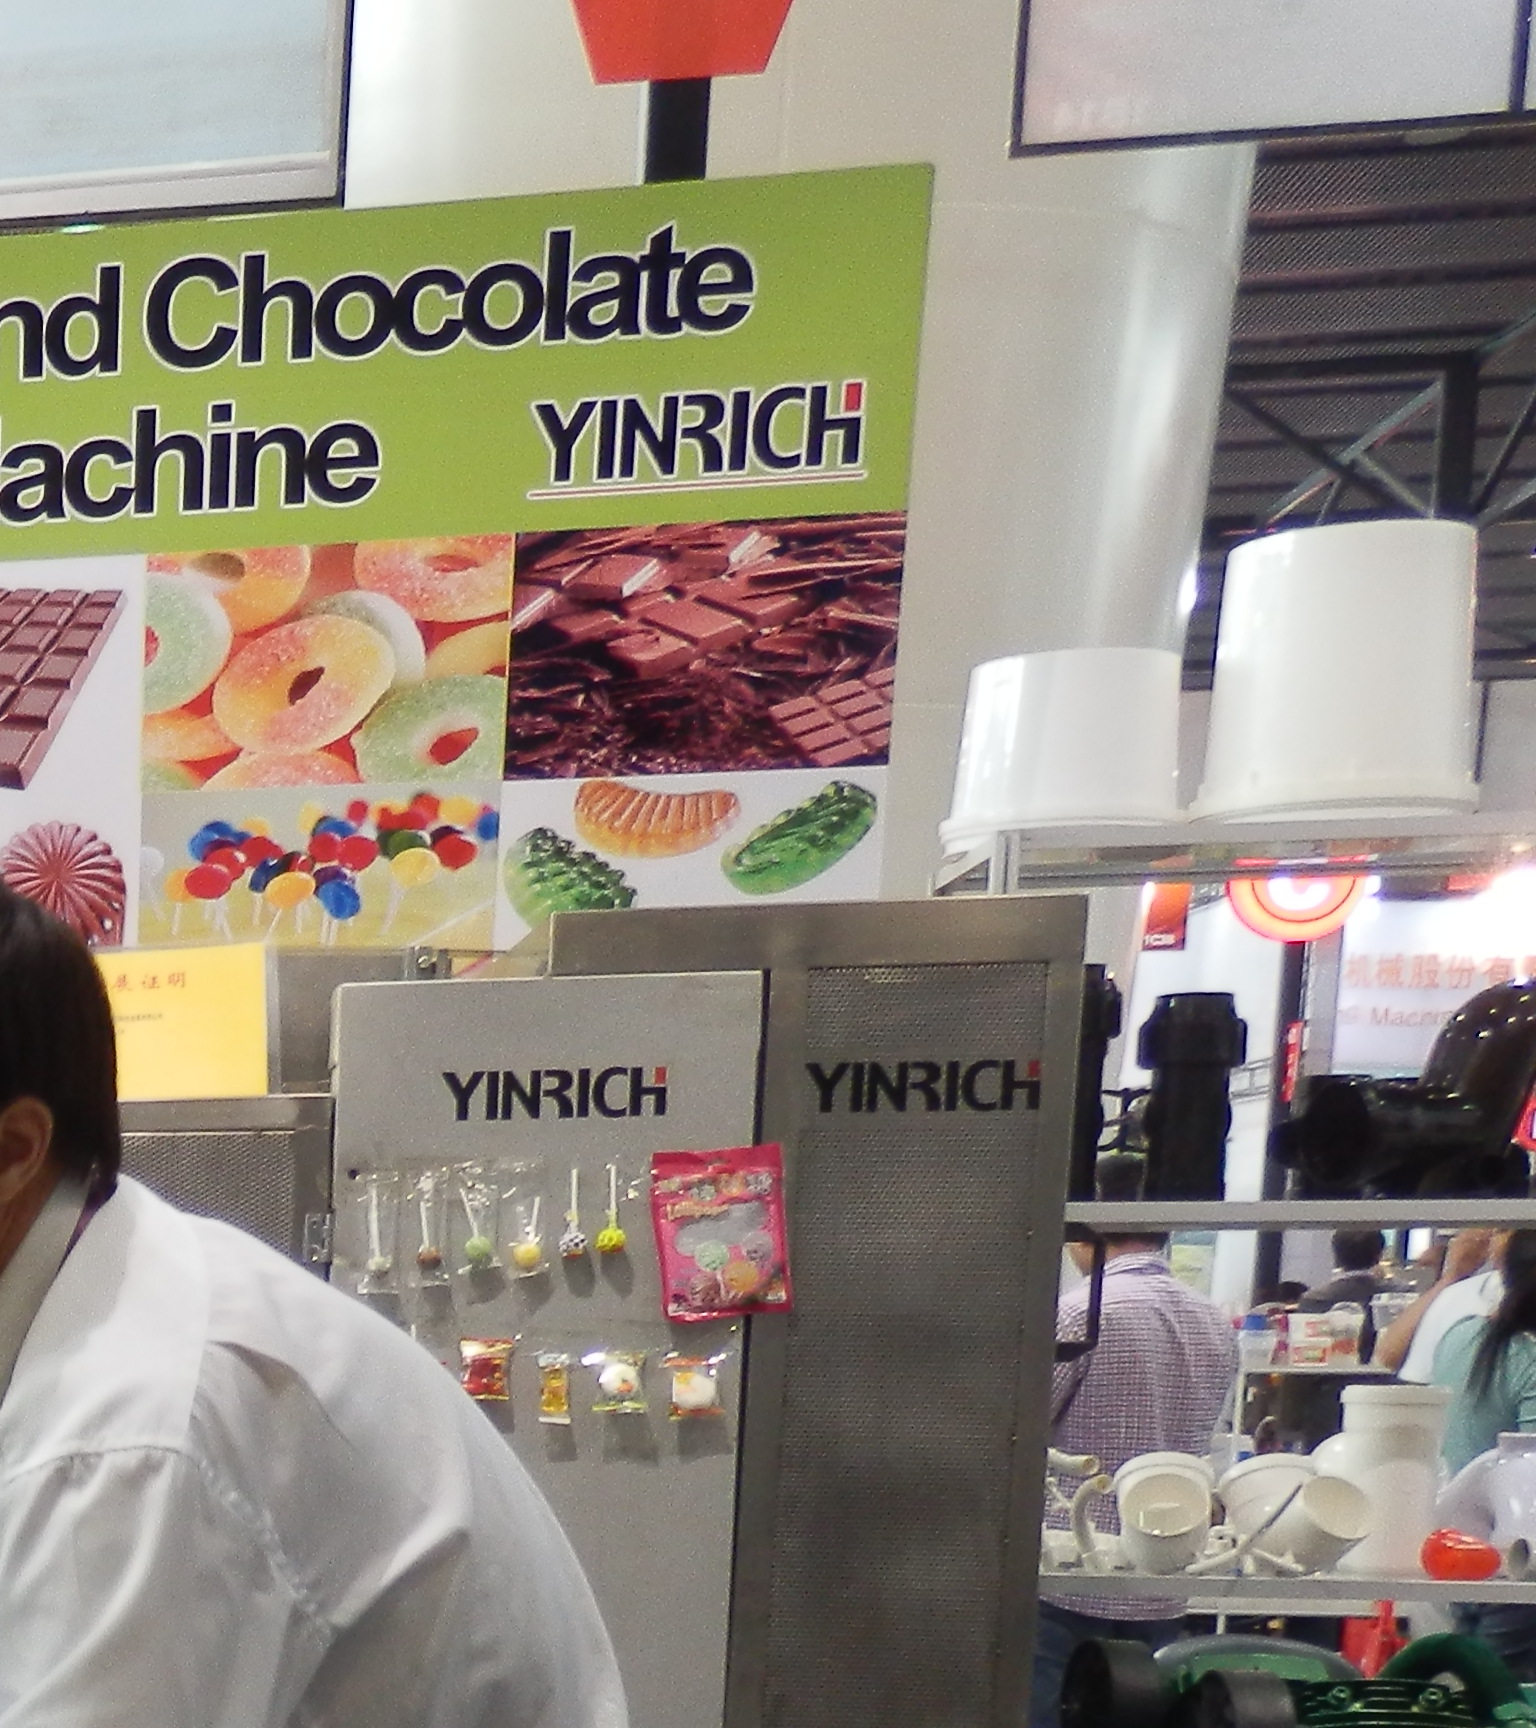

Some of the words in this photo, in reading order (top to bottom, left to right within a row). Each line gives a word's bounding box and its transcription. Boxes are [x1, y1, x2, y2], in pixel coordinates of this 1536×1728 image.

[145, 222, 756, 372] Chocolate
[533, 380, 865, 485] YINRICH
[1346, 953, 1536, 989] 机械股份有
[443, 1066, 667, 1121] YINRICH
[805, 1058, 1040, 1113] YINRICH
